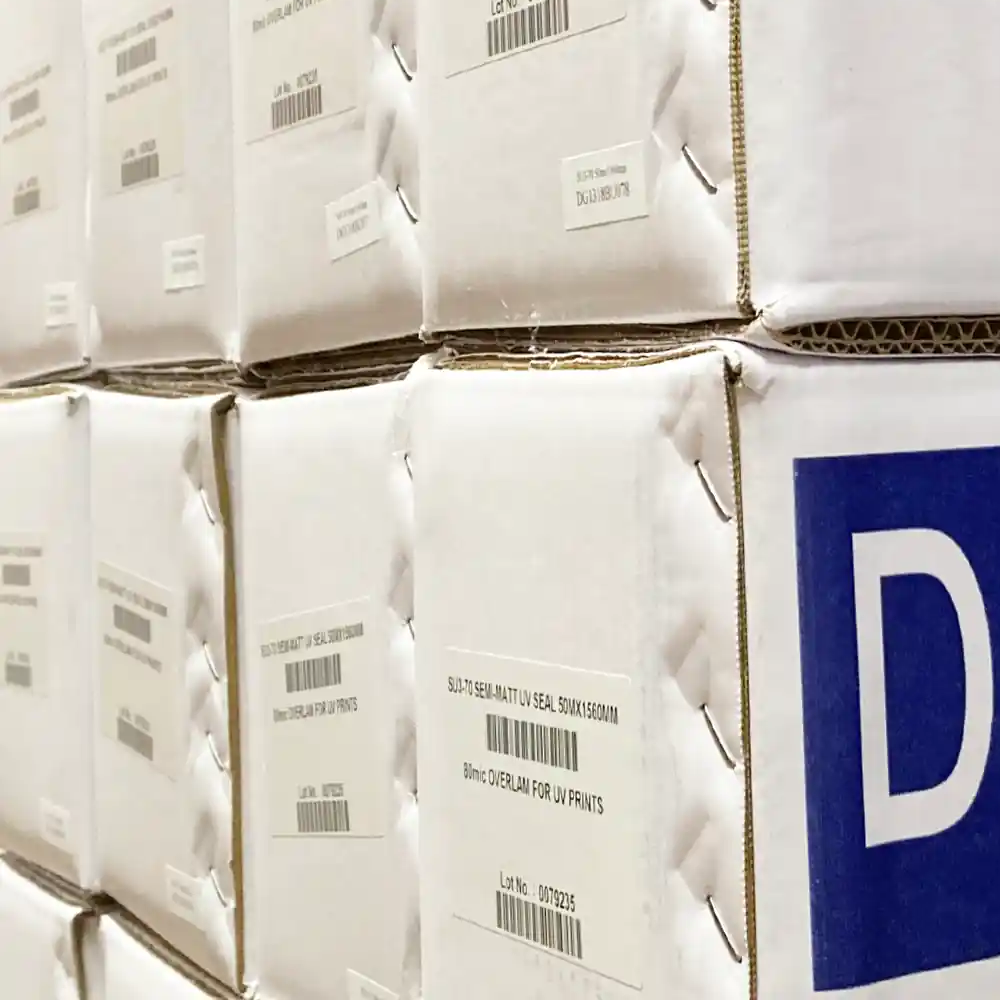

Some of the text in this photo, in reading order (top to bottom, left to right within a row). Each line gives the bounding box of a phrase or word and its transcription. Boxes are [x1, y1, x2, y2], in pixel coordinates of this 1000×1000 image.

[447, 676, 619, 726] SU3-70 SEMI-MATT UV SEAL 50MX1560MM
[463, 762, 605, 816] 80mic OVERLAM FOR UV PRINTS
[500, 871, 513, 891] Lot
[538, 884, 576, 913] 0079235
